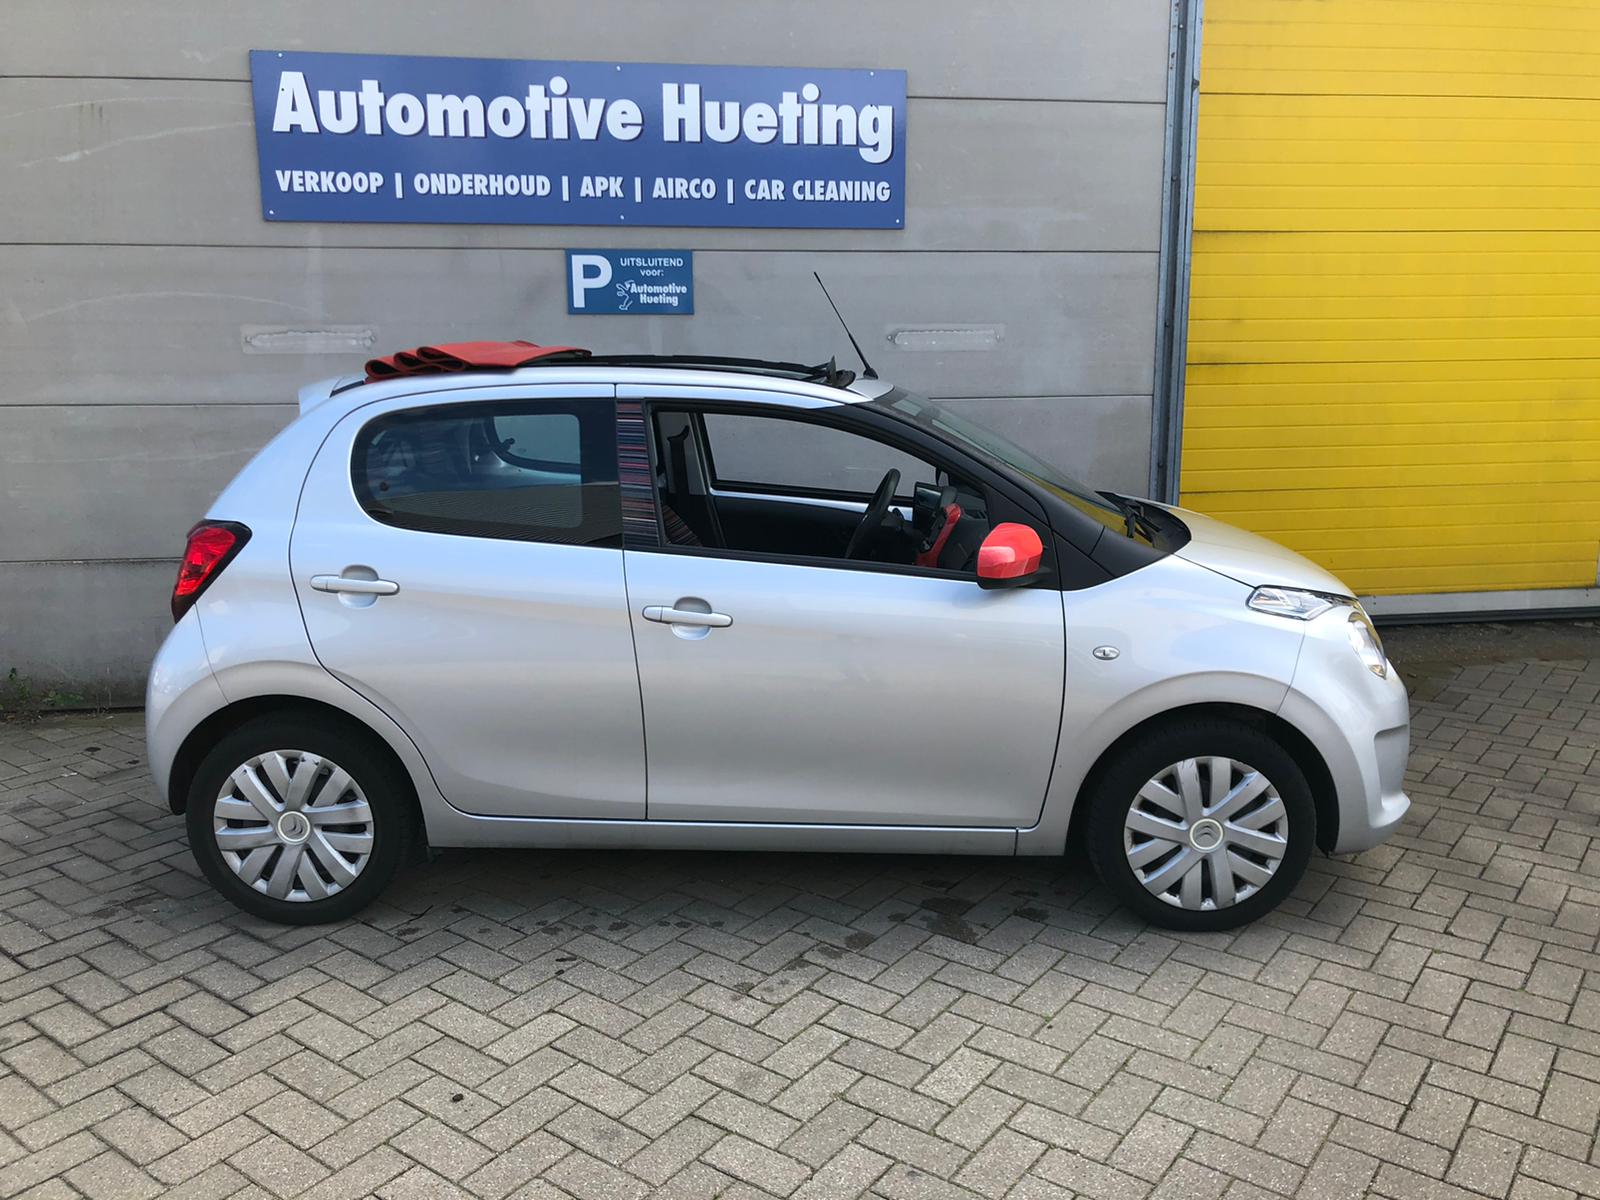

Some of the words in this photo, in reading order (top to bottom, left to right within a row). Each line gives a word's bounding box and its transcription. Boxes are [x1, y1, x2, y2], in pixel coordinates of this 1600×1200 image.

[272, 71, 643, 141] Automotive
[662, 82, 895, 164] Hueting
[275, 169, 384, 194] VERKOOP
[413, 172, 551, 196] ONDERHOUD
[579, 176, 624, 198] APK
[652, 177, 716, 199] AIRCO
[744, 178, 786, 201] CAR
[792, 179, 891, 202] CLEANING
[620, 257, 684, 267] UITSLUITEND
[571, 254, 613, 308] P
[630, 283, 688, 293] Automotive
[640, 294, 679, 306] Hueting
